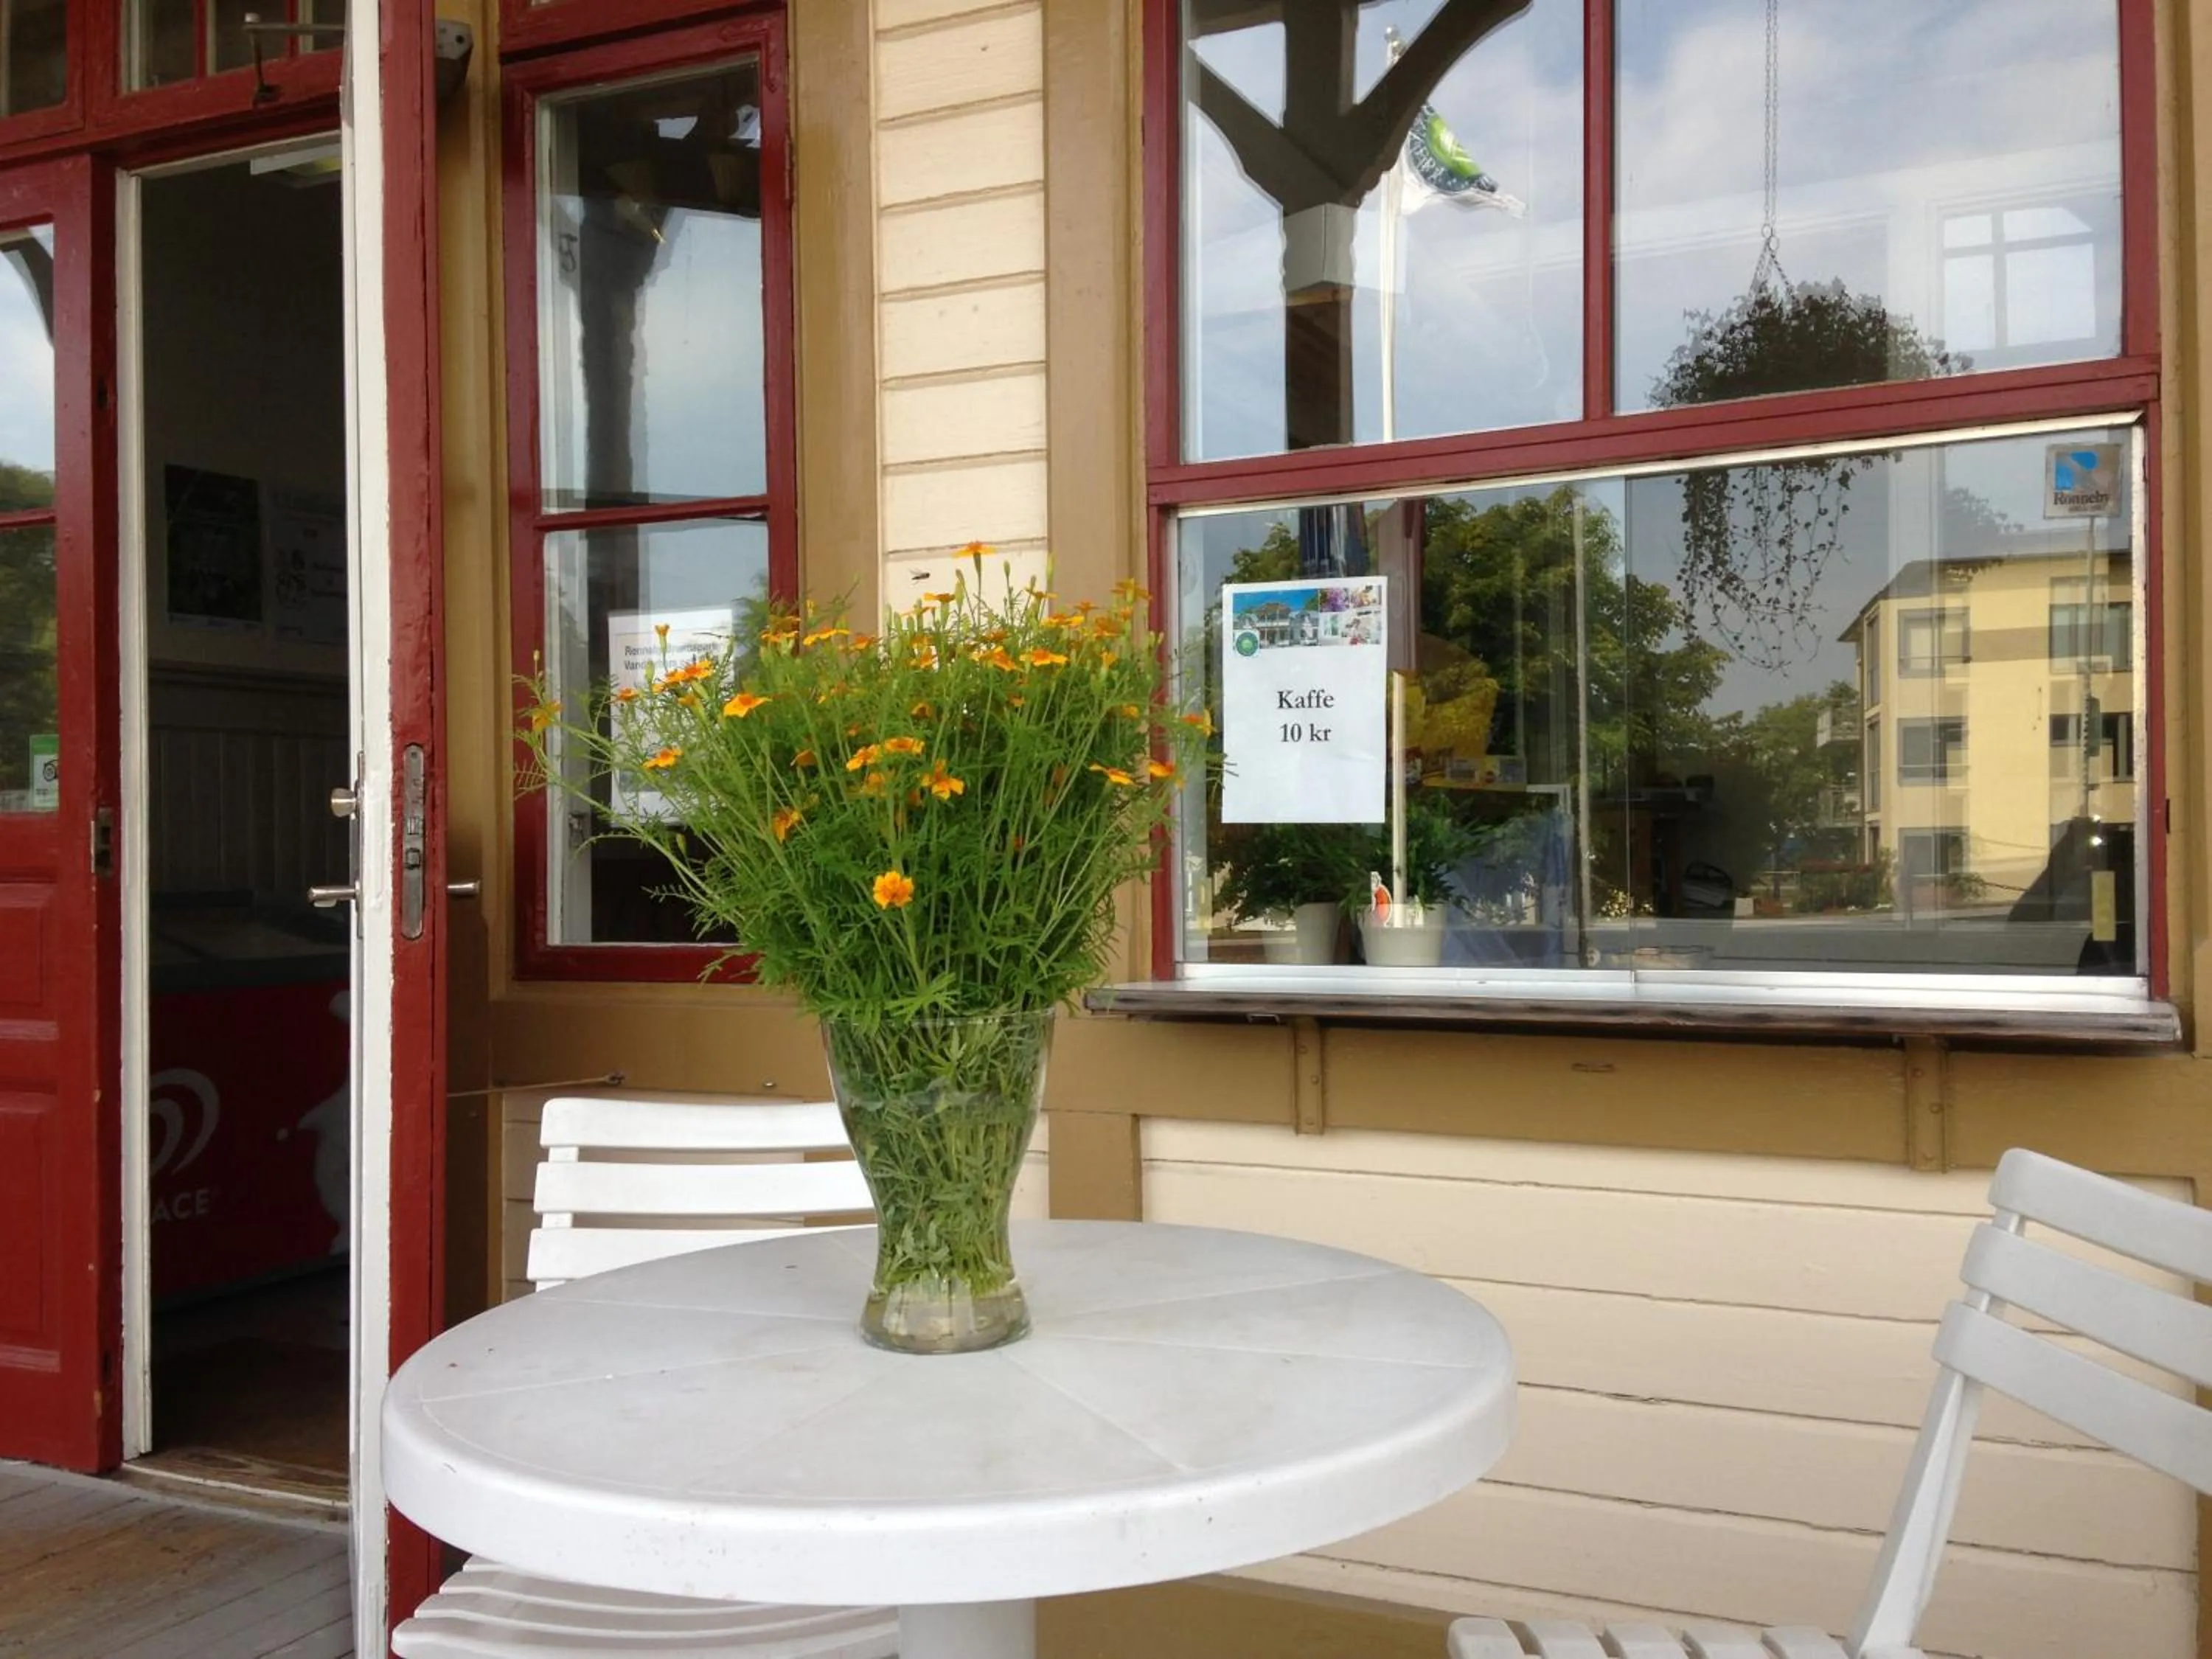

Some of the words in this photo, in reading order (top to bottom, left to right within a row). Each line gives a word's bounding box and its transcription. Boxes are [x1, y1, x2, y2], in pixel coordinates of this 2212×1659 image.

[1277, 689, 1335, 709] Kaffe
[1280, 723, 1302, 742] 10
[1310, 723, 1332, 742] kr
